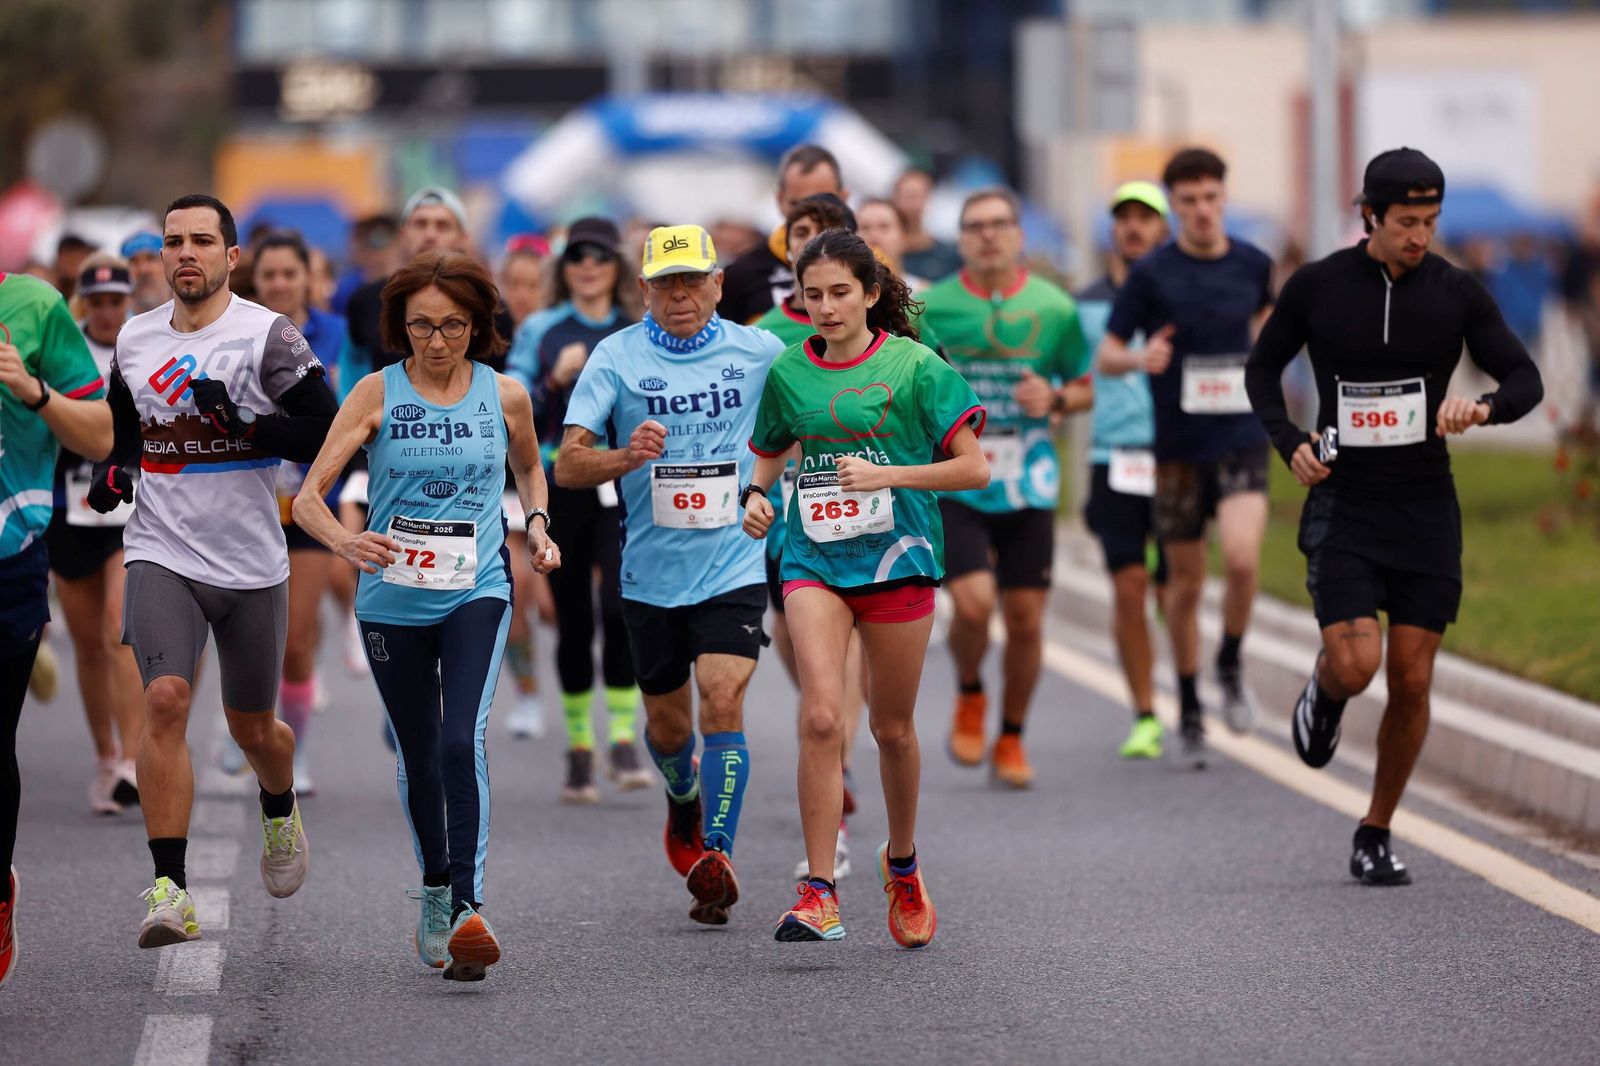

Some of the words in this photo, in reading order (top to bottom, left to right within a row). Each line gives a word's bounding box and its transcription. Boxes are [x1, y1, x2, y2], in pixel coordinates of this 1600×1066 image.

[663, 235, 689, 253] als
[722, 364, 744, 381] als
[641, 378, 667, 390] TROPS
[645, 383, 743, 418] nerja
[392, 404, 425, 419] TROPS
[1351, 411, 1398, 429] 596
[390, 417, 473, 445] nerja
[665, 420, 733, 437] ATLETISMO
[143, 440, 179, 454] MEDIA
[184, 438, 252, 454] ELCHE
[400, 447, 463, 457] ATLETISMO
[701, 468, 719, 476] 2026
[424, 481, 457, 496] TROPS
[803, 491, 838, 499] #YoCorroPor
[673, 492, 706, 510] 69
[810, 499, 860, 521] 263
[408, 522, 431, 530] Marcha
[434, 526, 453, 534] 2026
[393, 534, 426, 546] #YoCorroPor
[404, 548, 436, 568] 72
